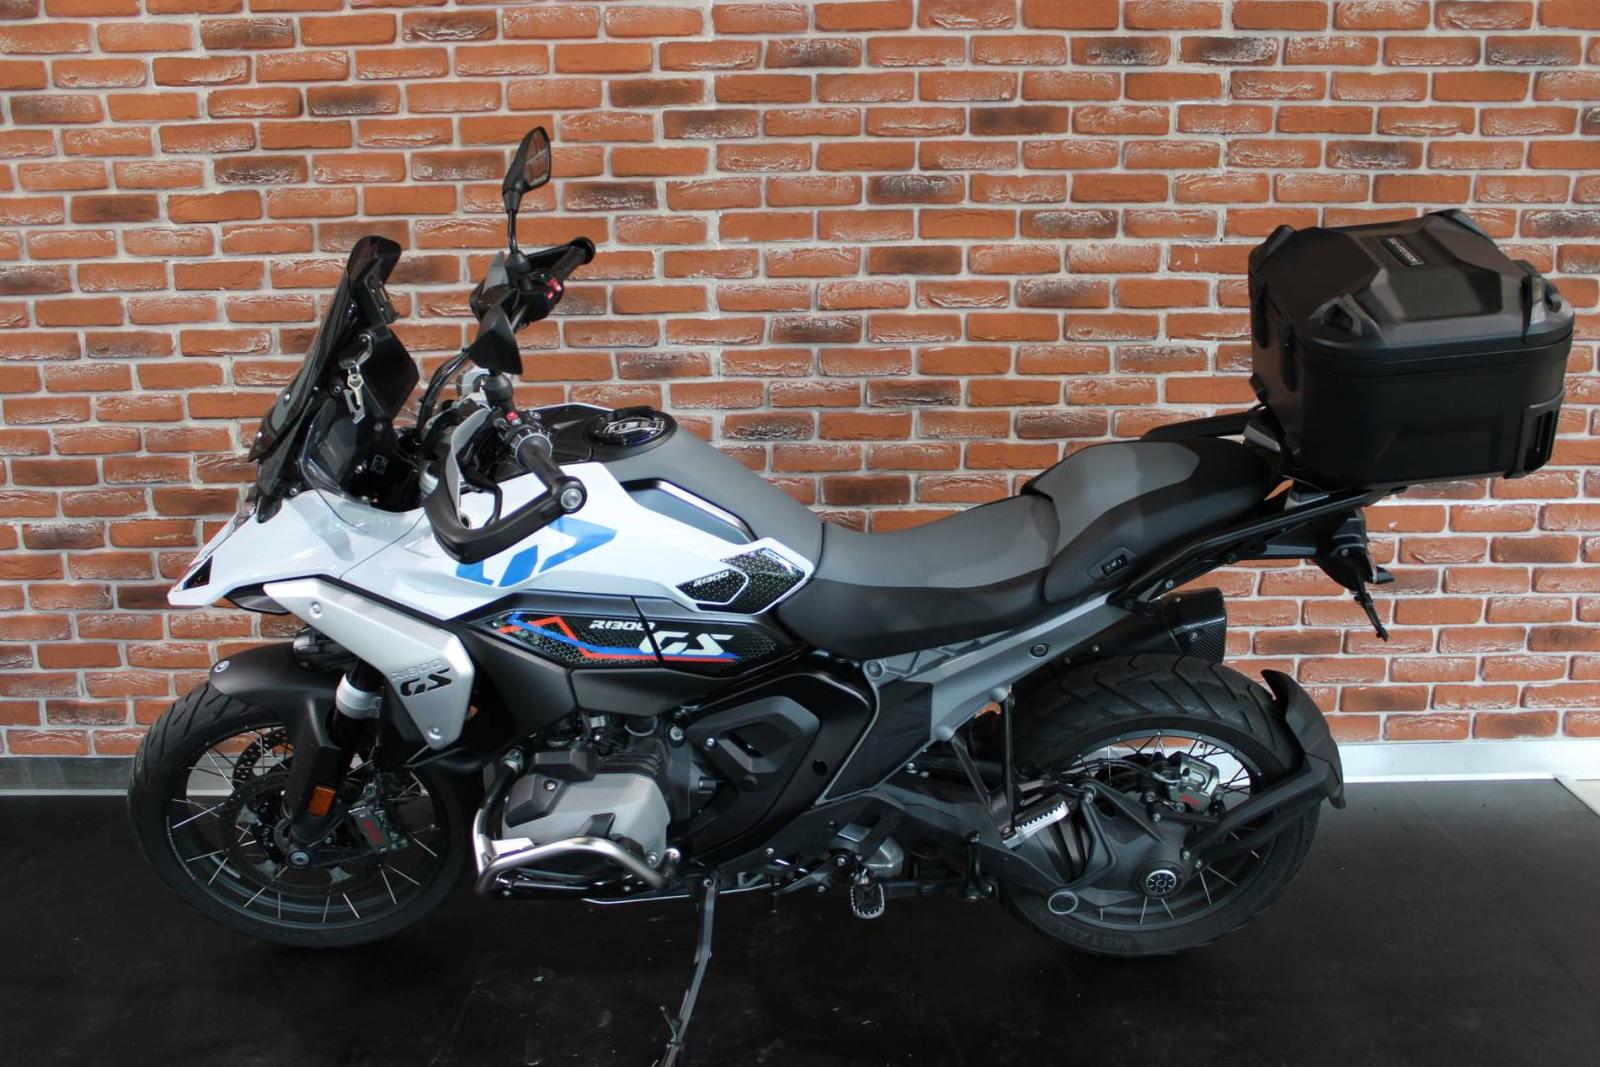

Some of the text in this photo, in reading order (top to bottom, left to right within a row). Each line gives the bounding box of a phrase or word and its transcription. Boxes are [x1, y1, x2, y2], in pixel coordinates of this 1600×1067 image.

[589, 620, 656, 632] R1300
[638, 630, 735, 656] GS
[400, 667, 453, 697] GS
